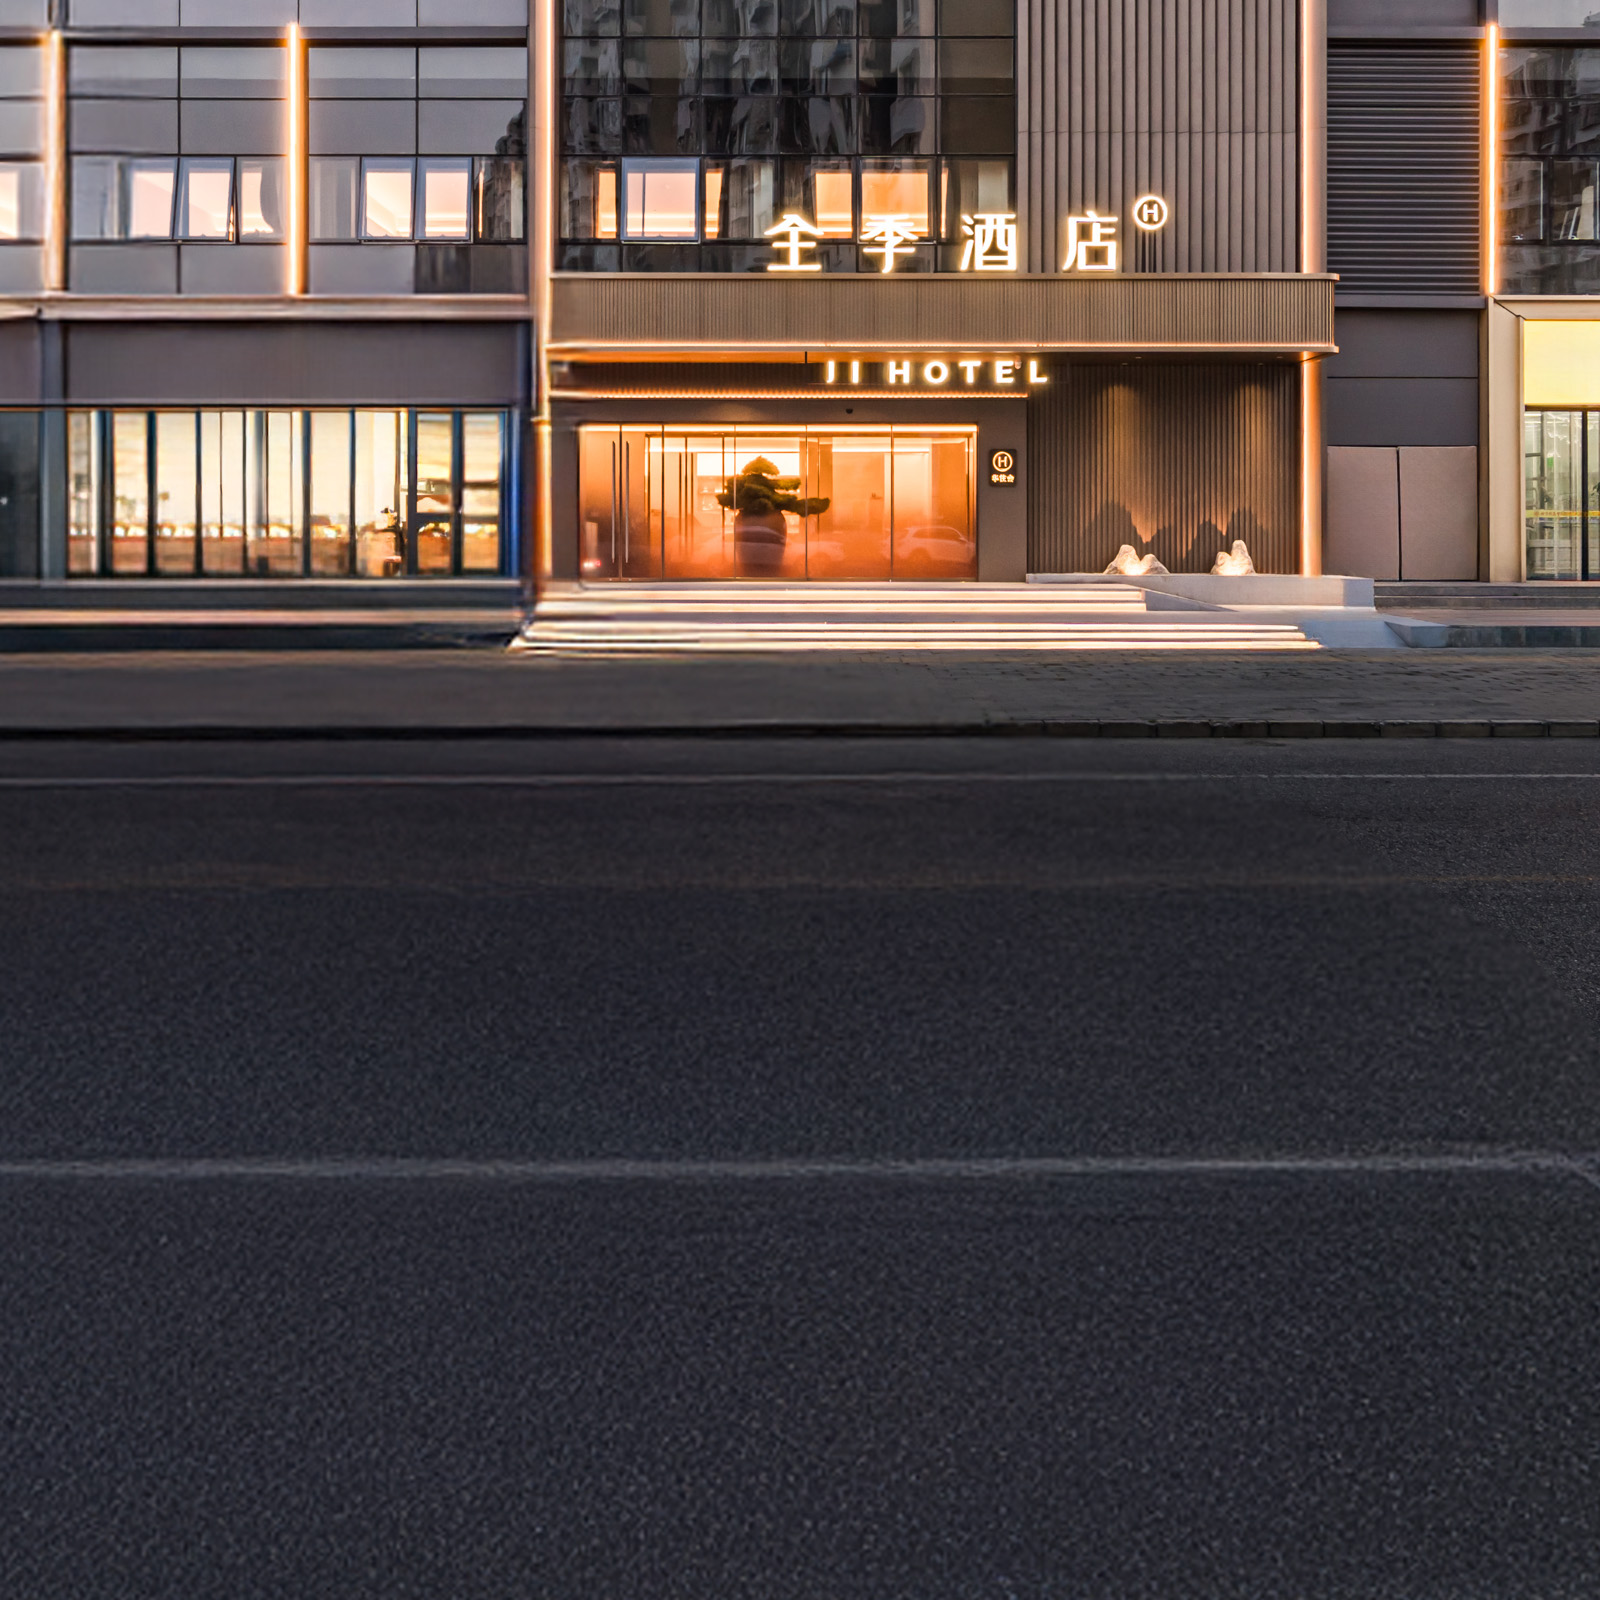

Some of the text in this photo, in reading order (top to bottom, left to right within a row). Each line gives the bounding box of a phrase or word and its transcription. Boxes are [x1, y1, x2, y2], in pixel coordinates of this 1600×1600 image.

[764, 211, 1119, 274] 全季酒店
[826, 360, 1048, 384] JI HOTEL
